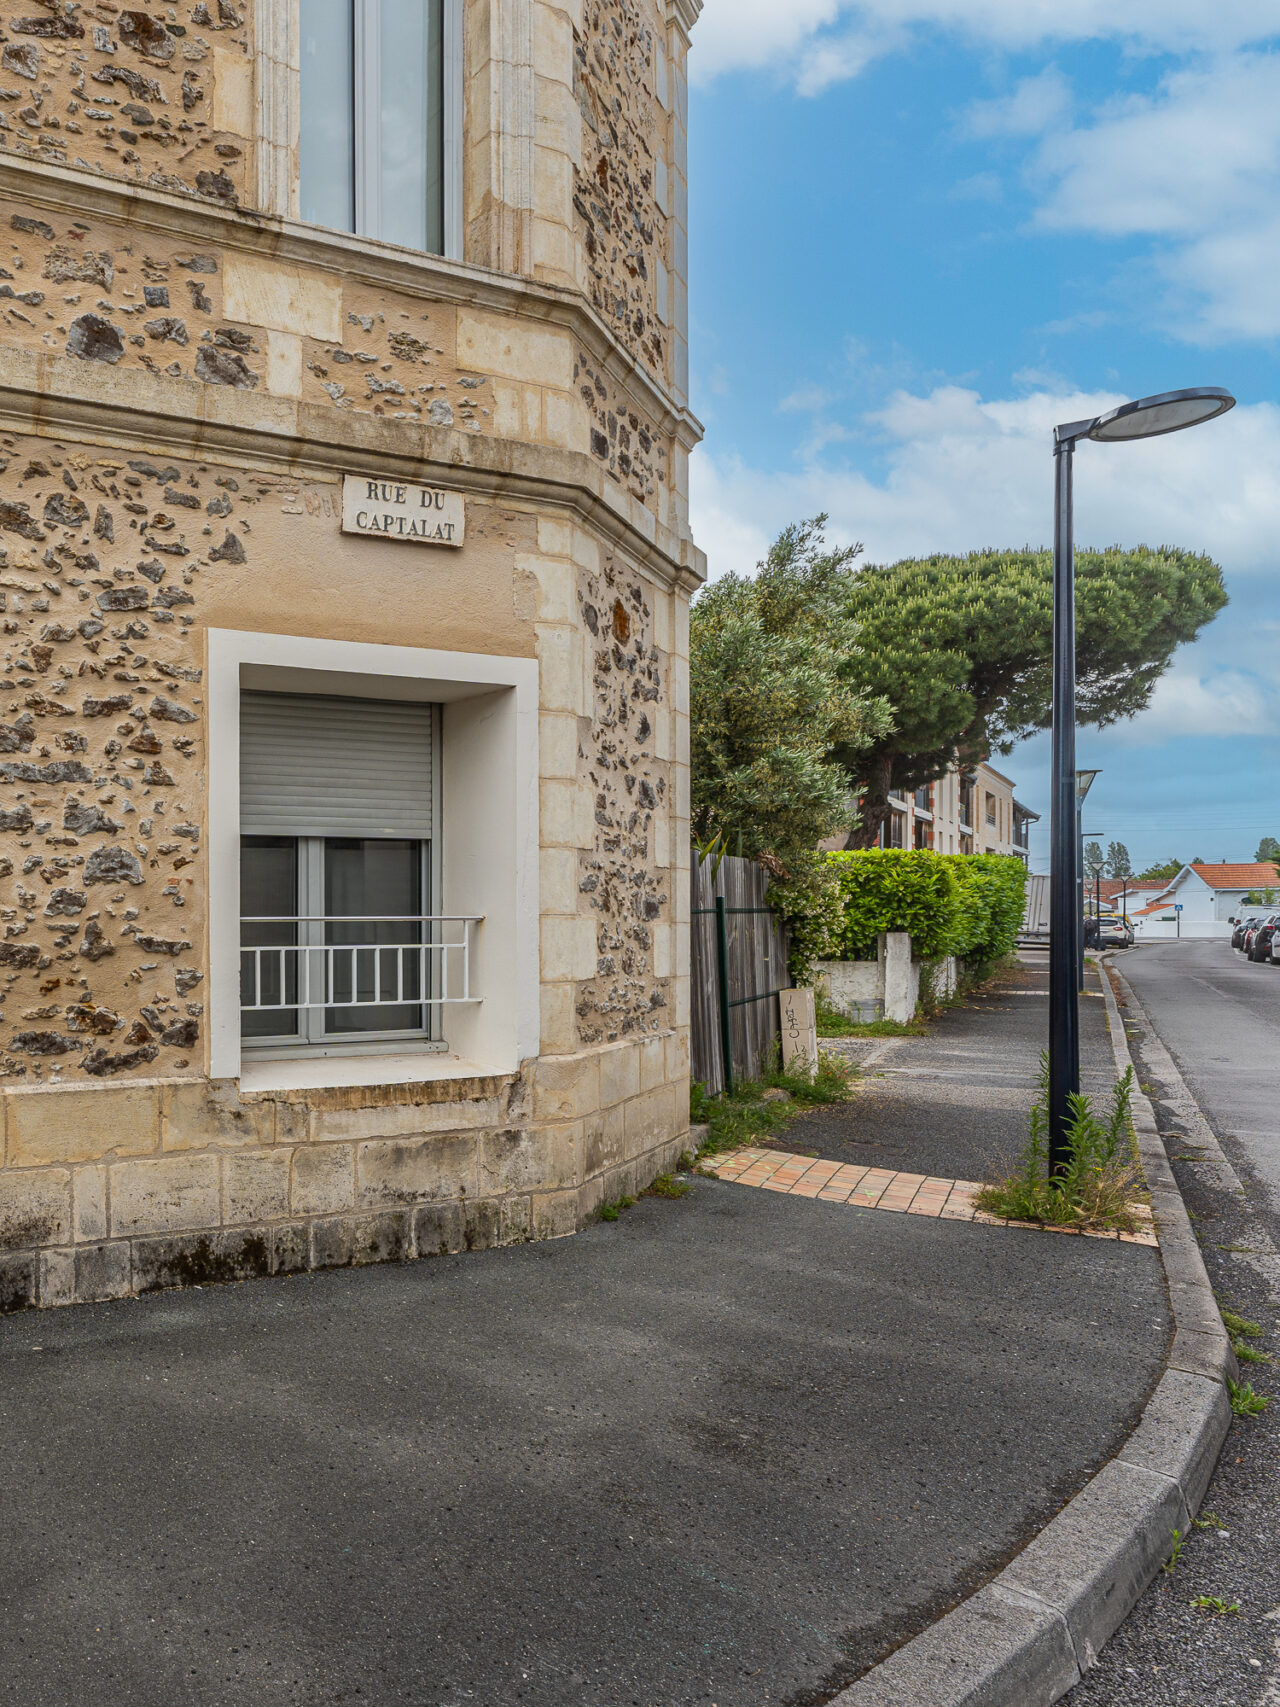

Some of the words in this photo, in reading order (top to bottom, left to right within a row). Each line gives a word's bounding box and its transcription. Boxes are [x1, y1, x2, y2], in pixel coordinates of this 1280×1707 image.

[366, 481, 407, 504] RUE
[420, 489, 445, 510] DU
[356, 511, 455, 541] CAPTALAT
